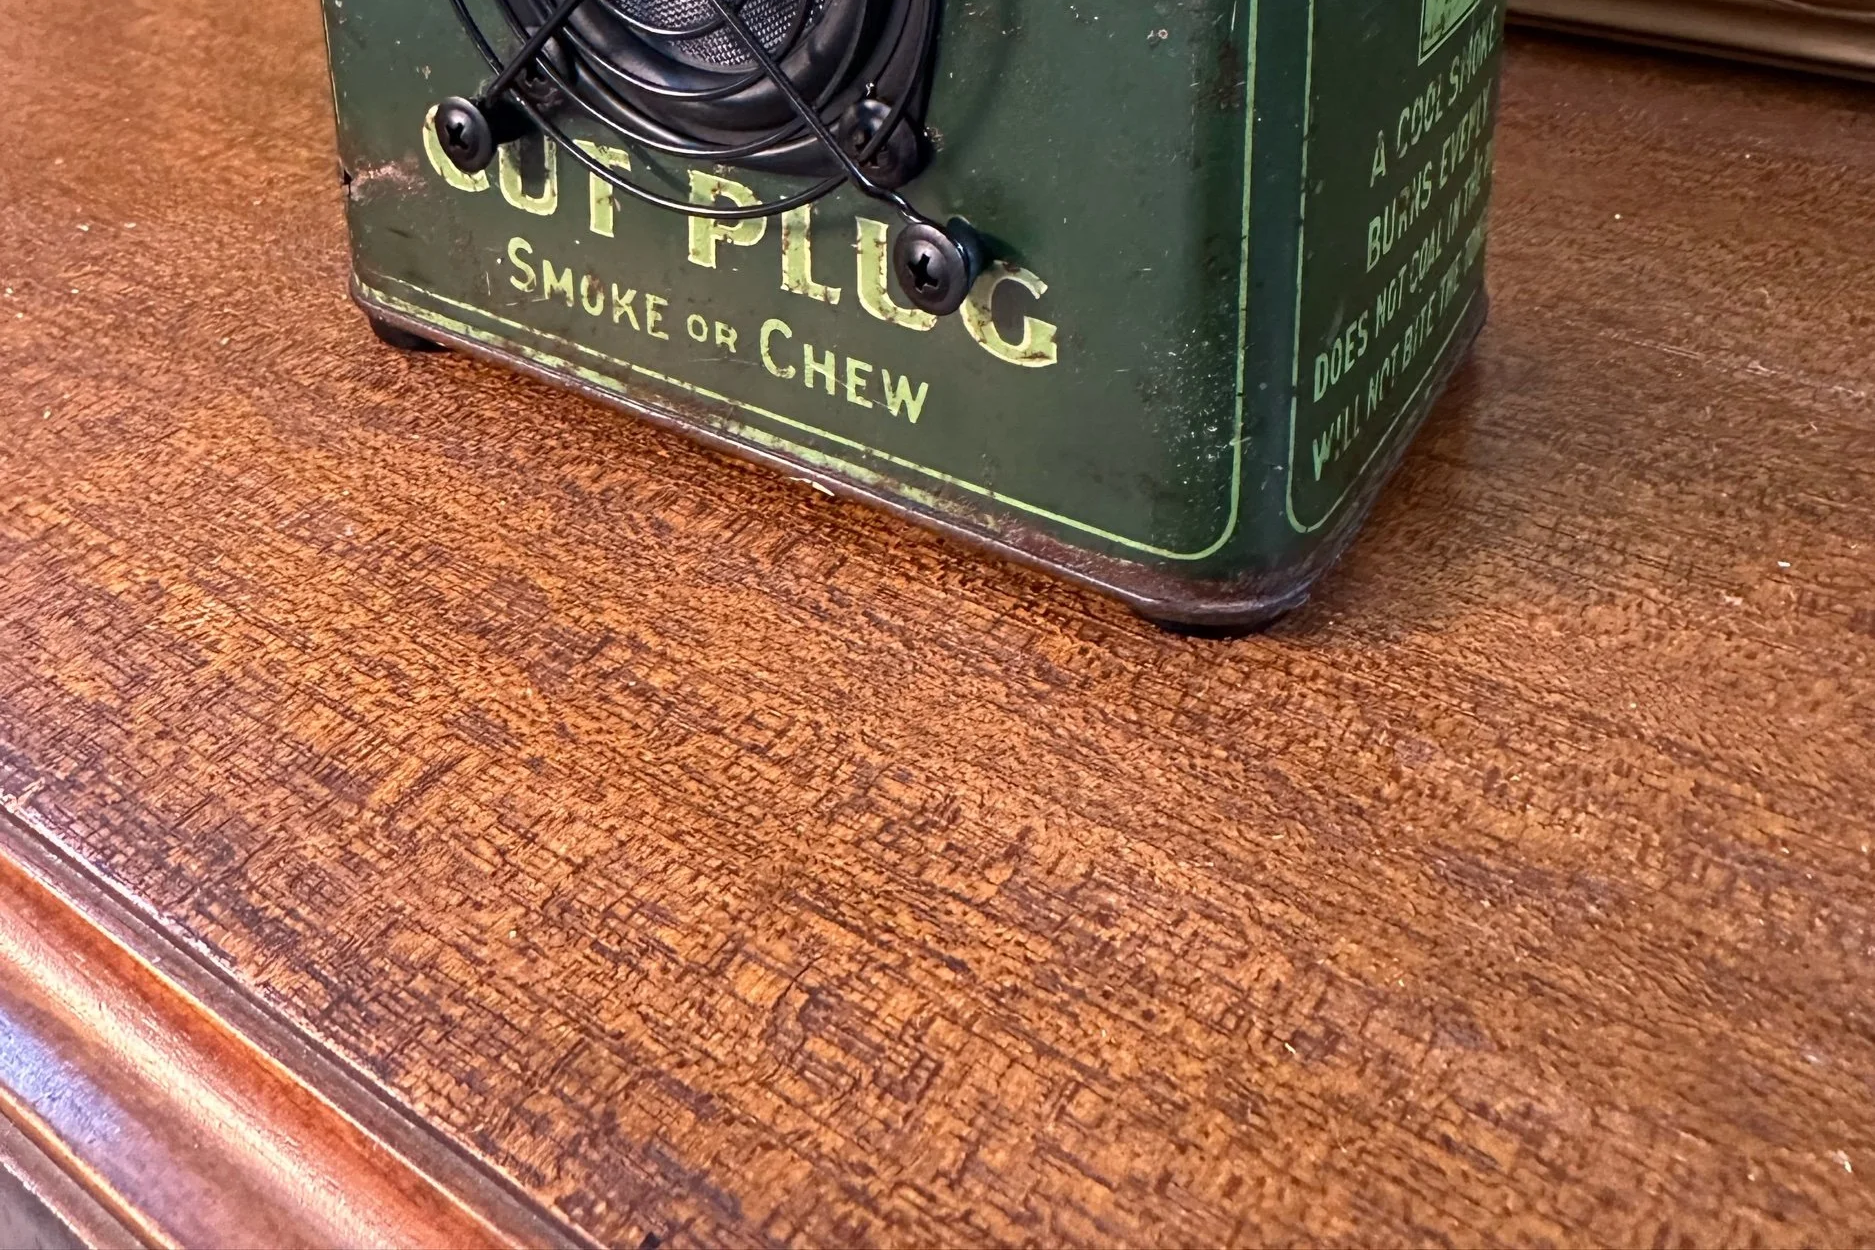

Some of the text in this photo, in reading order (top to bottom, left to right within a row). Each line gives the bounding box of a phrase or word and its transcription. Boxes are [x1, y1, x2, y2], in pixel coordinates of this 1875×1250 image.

[1371, 4, 1497, 187] A COOL SMOKE
[687, 169, 1058, 368] PLUG
[1313, 310, 1369, 403] DOES
[1375, 264, 1407, 338] NOT
[1410, 219, 1442, 293] COAL
[1446, 189, 1462, 243] IN
[1366, 161, 1433, 273] BURNS
[506, 236, 930, 425] SMOKE OR CHEW
[1312, 394, 1360, 482] WILL
[1366, 342, 1400, 420] NOT
[1401, 291, 1436, 374] BITE
